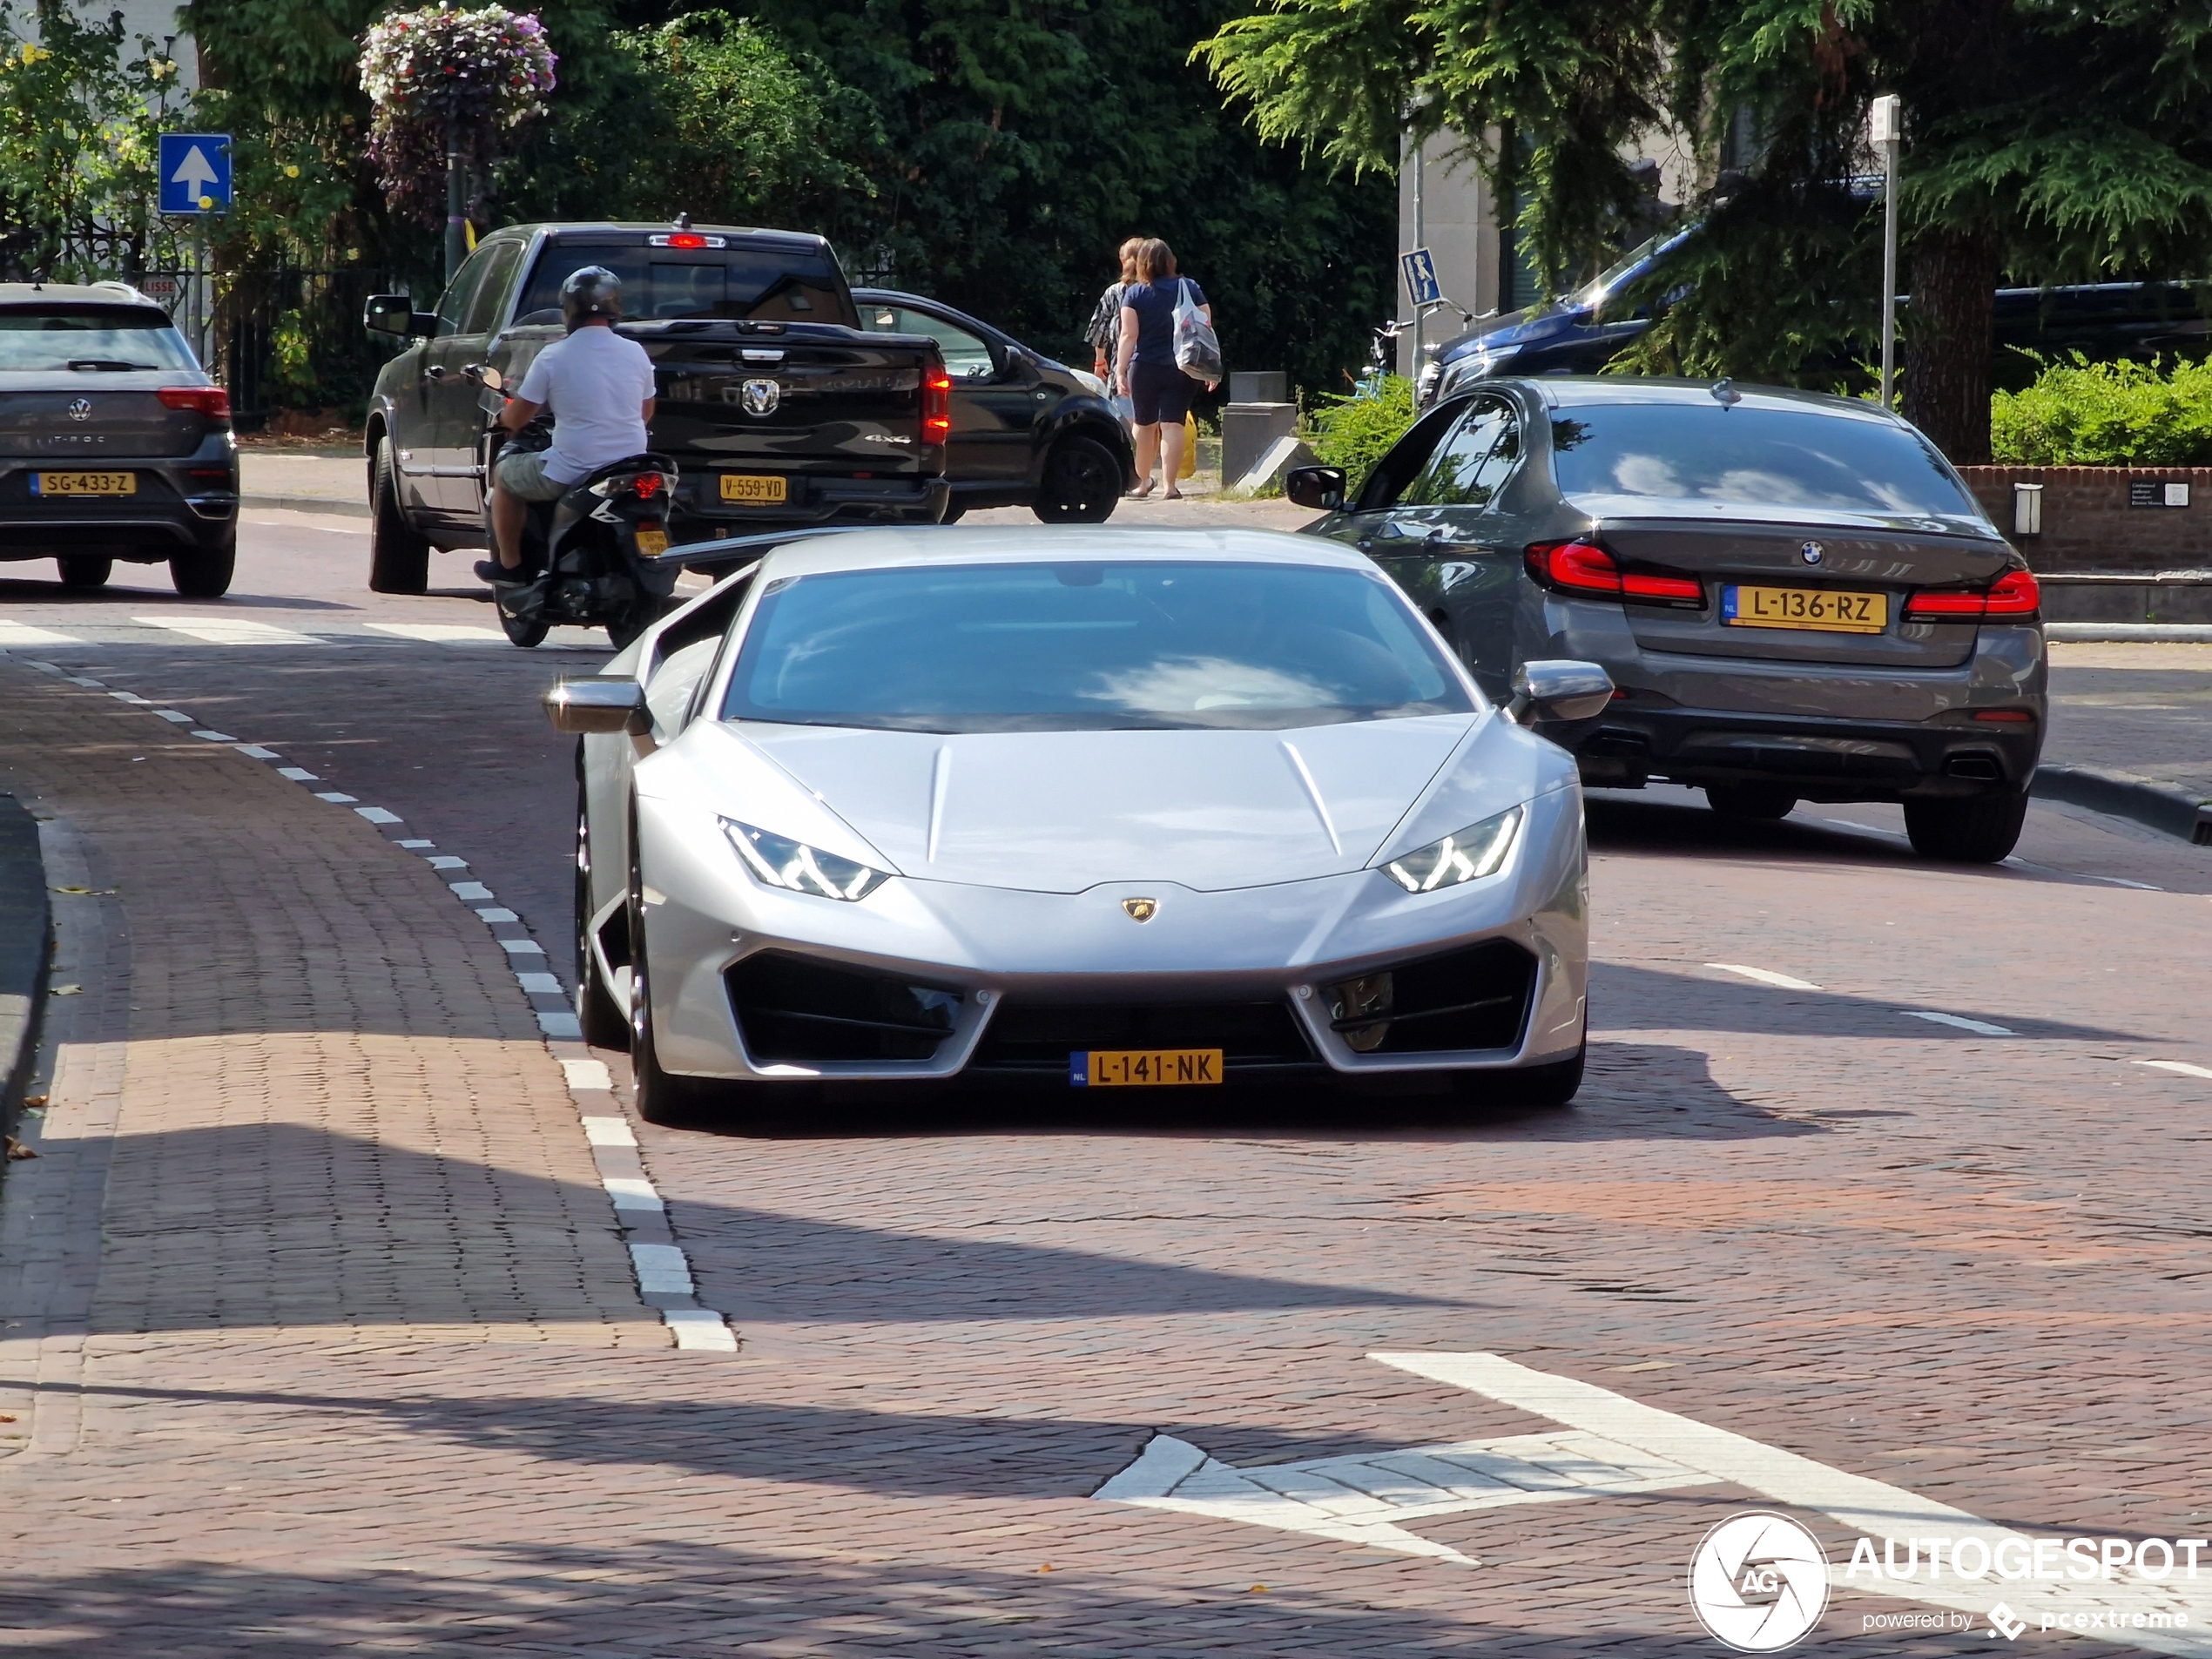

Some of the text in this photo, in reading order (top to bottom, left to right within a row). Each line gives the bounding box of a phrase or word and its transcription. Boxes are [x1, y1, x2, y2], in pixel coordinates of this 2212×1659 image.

[145, 281, 173, 292] LISSE
[47, 475, 128, 491] SG-433-Z
[725, 478, 782, 497] V-559-VD
[1724, 604, 1737, 614] NL
[1754, 590, 1871, 621] L-136-RZ
[1098, 1055, 1213, 1083] L-141-NK
[1073, 1073, 1087, 1082] NL
